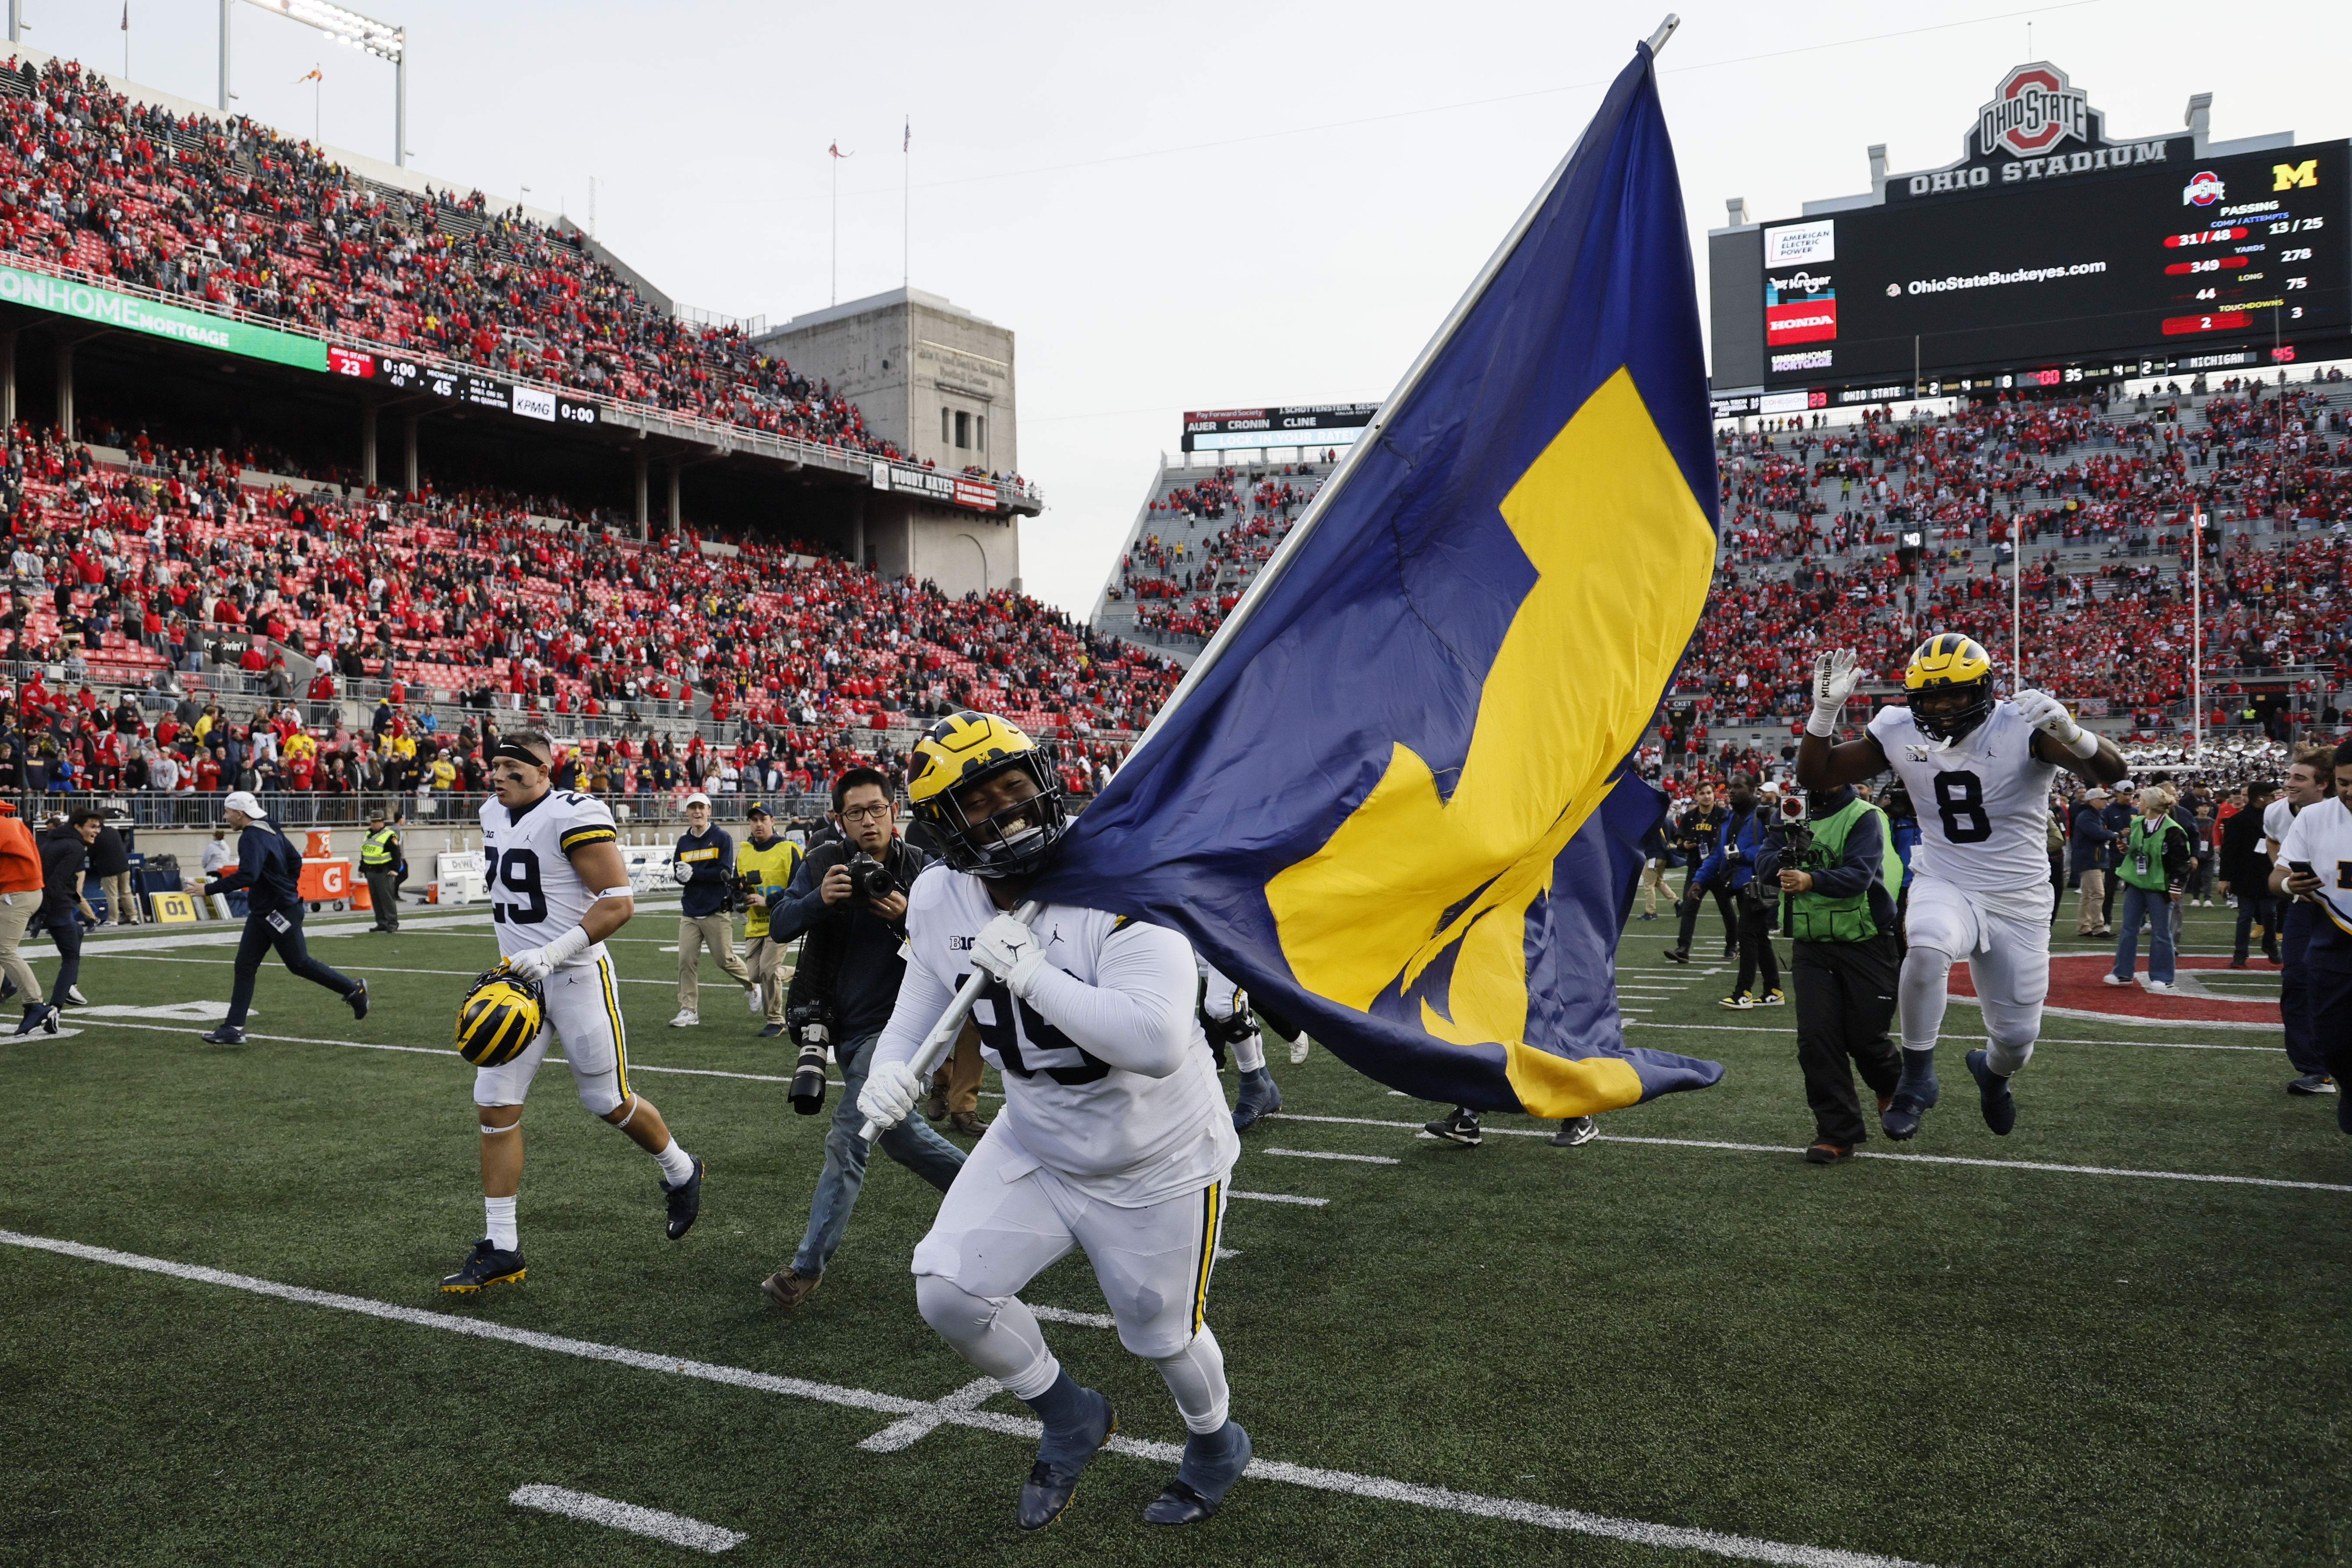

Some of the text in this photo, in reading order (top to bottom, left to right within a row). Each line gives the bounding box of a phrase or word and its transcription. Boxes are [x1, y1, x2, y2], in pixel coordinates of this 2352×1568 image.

[1909, 140, 2167, 196] OHIO STADIUM
[2272, 159, 2318, 192] M
[2220, 201, 2279, 216] PASSING
[2210, 218, 2236, 228] COMP
[2242, 212, 2289, 223] ATTEMPTS
[1782, 238, 1819, 248] ELECTRIC
[1783, 231, 1830, 241] AMERICAN
[1781, 247, 1813, 255] POWER
[2235, 244, 2266, 253] YARDS
[2281, 248, 2312, 262] 278
[2191, 259, 2220, 273] 349
[1789, 272, 1831, 293] Kroger
[1908, 261, 2106, 294] OhioStateBuckeyes.com
[2238, 273, 2264, 282] LONG
[2286, 277, 2308, 290] 75
[2196, 288, 2216, 300] 44
[2218, 299, 2284, 312] TOUCHDOWNS
[2291, 307, 2303, 318] 3
[1770, 315, 1834, 331] HONDA
[2200, 317, 2212, 328] 2
[139, 317, 229, 347] MORTGAGE
[331, 347, 371, 362] OHIO STATE
[2190, 353, 2245, 368] MICHIGAN
[2271, 346, 2296, 361] 45
[340, 359, 361, 376] 23
[383, 358, 416, 378] 0:00
[1772, 357, 1832, 372] MORTGAGE
[2113, 365, 2123, 376] 4
[2142, 361, 2152, 374] 2
[391, 374, 405, 387] 40
[427, 369, 457, 382] MICHIGAN
[2002, 375, 2012, 388] 8
[2065, 368, 2083, 382] 35
[2084, 369, 2100, 377] BALL
[433, 379, 452, 396] 45
[470, 387, 485, 396] BALL
[1928, 382, 1938, 396] 2
[1961, 379, 1971, 391] 4
[1809, 392, 1827, 408] 23
[1842, 386, 1901, 402] OHIO STATE
[480, 397, 508, 409] QUARTER
[516, 397, 550, 416] KPMG
[1718, 404, 1748, 412] GEORGIA
[1763, 397, 1806, 406] COHESION
[561, 404, 595, 423] 0:00
[1196, 409, 1263, 420] Pay Forward Society
[1187, 417, 1317, 432] AUER CRONIN CLINE
[1219, 430, 1354, 447] LOCK IN YOUR RATE!
[891, 468, 955, 495] WOODY HAYES
[957, 482, 964, 491] 13
[957, 491, 961, 500] 5
[961, 493, 982, 503] NATIONAL
[1904, 533, 1920, 546] 40
[221, 641, 242, 651] ovin'
[974, 751, 991, 764] M
[1934, 770, 1992, 844] 8
[686, 850, 713, 860] MICHIGAN
[323, 867, 342, 893] G
[484, 846, 547, 924] 29
[165, 901, 187, 916] 01
